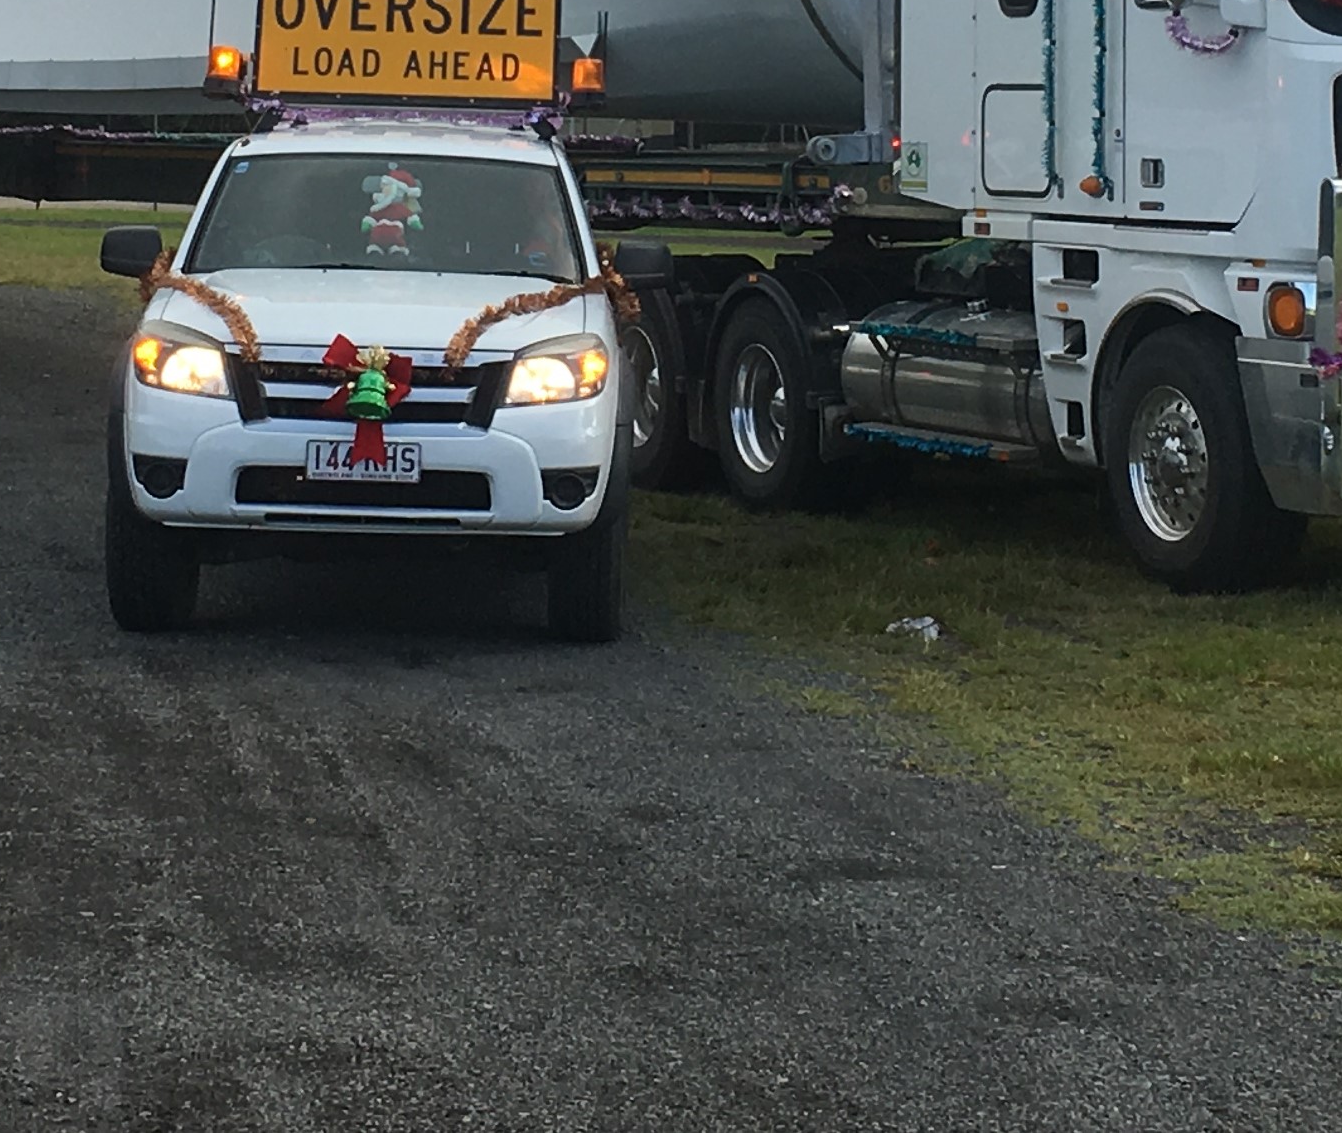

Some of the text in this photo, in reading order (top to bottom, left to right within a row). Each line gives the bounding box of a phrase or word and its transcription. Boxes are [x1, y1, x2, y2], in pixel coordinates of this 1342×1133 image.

[292, 46, 520, 82] LOAD AHEAD
[315, 443, 354, 471] 144
